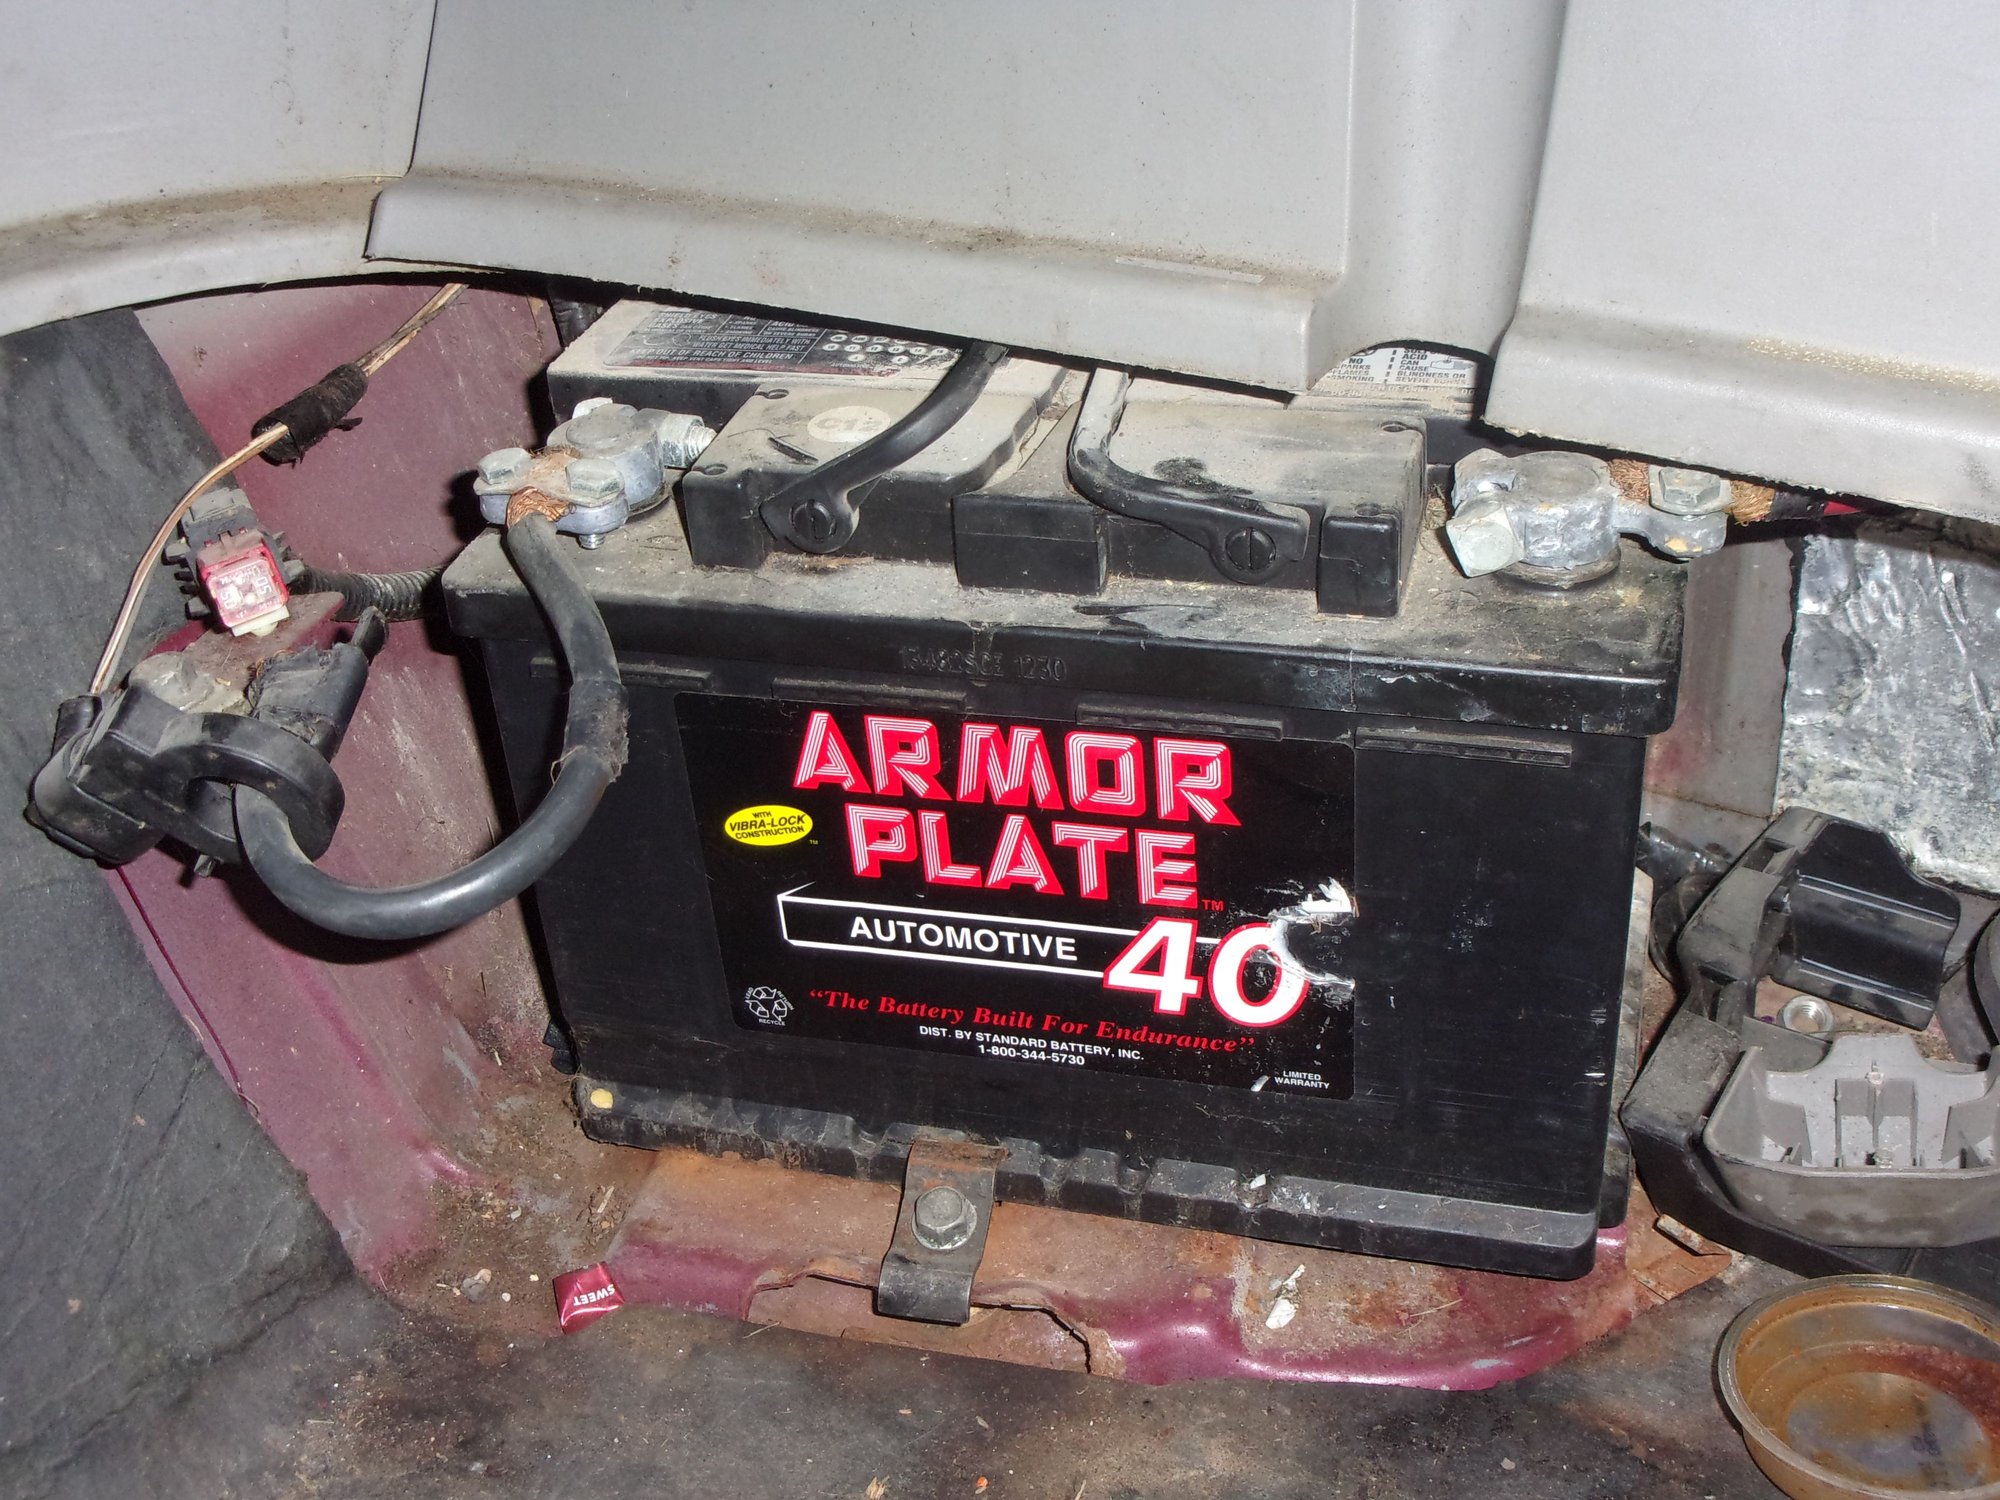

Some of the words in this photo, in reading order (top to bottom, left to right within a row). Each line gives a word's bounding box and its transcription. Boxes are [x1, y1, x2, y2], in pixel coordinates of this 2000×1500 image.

[741, 336, 790, 344] IMMEDIATELY
[742, 352, 794, 360] CHILDREN
[1348, 357, 1365, 365] NO
[1395, 376, 1431, 384] SEVERE
[1396, 371, 1450, 379] BLINDNESS
[793, 711, 1242, 826] ARMOR
[752, 810, 773, 819] WITH
[729, 814, 807, 832] VIBRA-LOCK
[735, 825, 806, 840] CONSTRUCTION
[844, 802, 1199, 909] PLATE
[850, 916, 1079, 962] AUTOMOTIVE
[1103, 915, 1311, 1029] 40
[758, 1018, 787, 1027] RECYCLE
[878, 996, 965, 1025] Battery
[973, 1006, 1035, 1030] Built
[1041, 1014, 1090, 1036] For
[919, 1025, 951, 1039] DIST.
[954, 1029, 973, 1041] BY
[975, 1031, 1048, 1050] STANDARD
[1050, 1040, 1116, 1060] BATTERY,
[1118, 1048, 1145, 1061] INC.
[978, 1044, 1086, 1067] 1-800-344-5730
[1274, 1076, 1330, 1089] WARRANTY
[1282, 1070, 1322, 1081] LIMITED
[573, 1283, 616, 1307] SWEET
